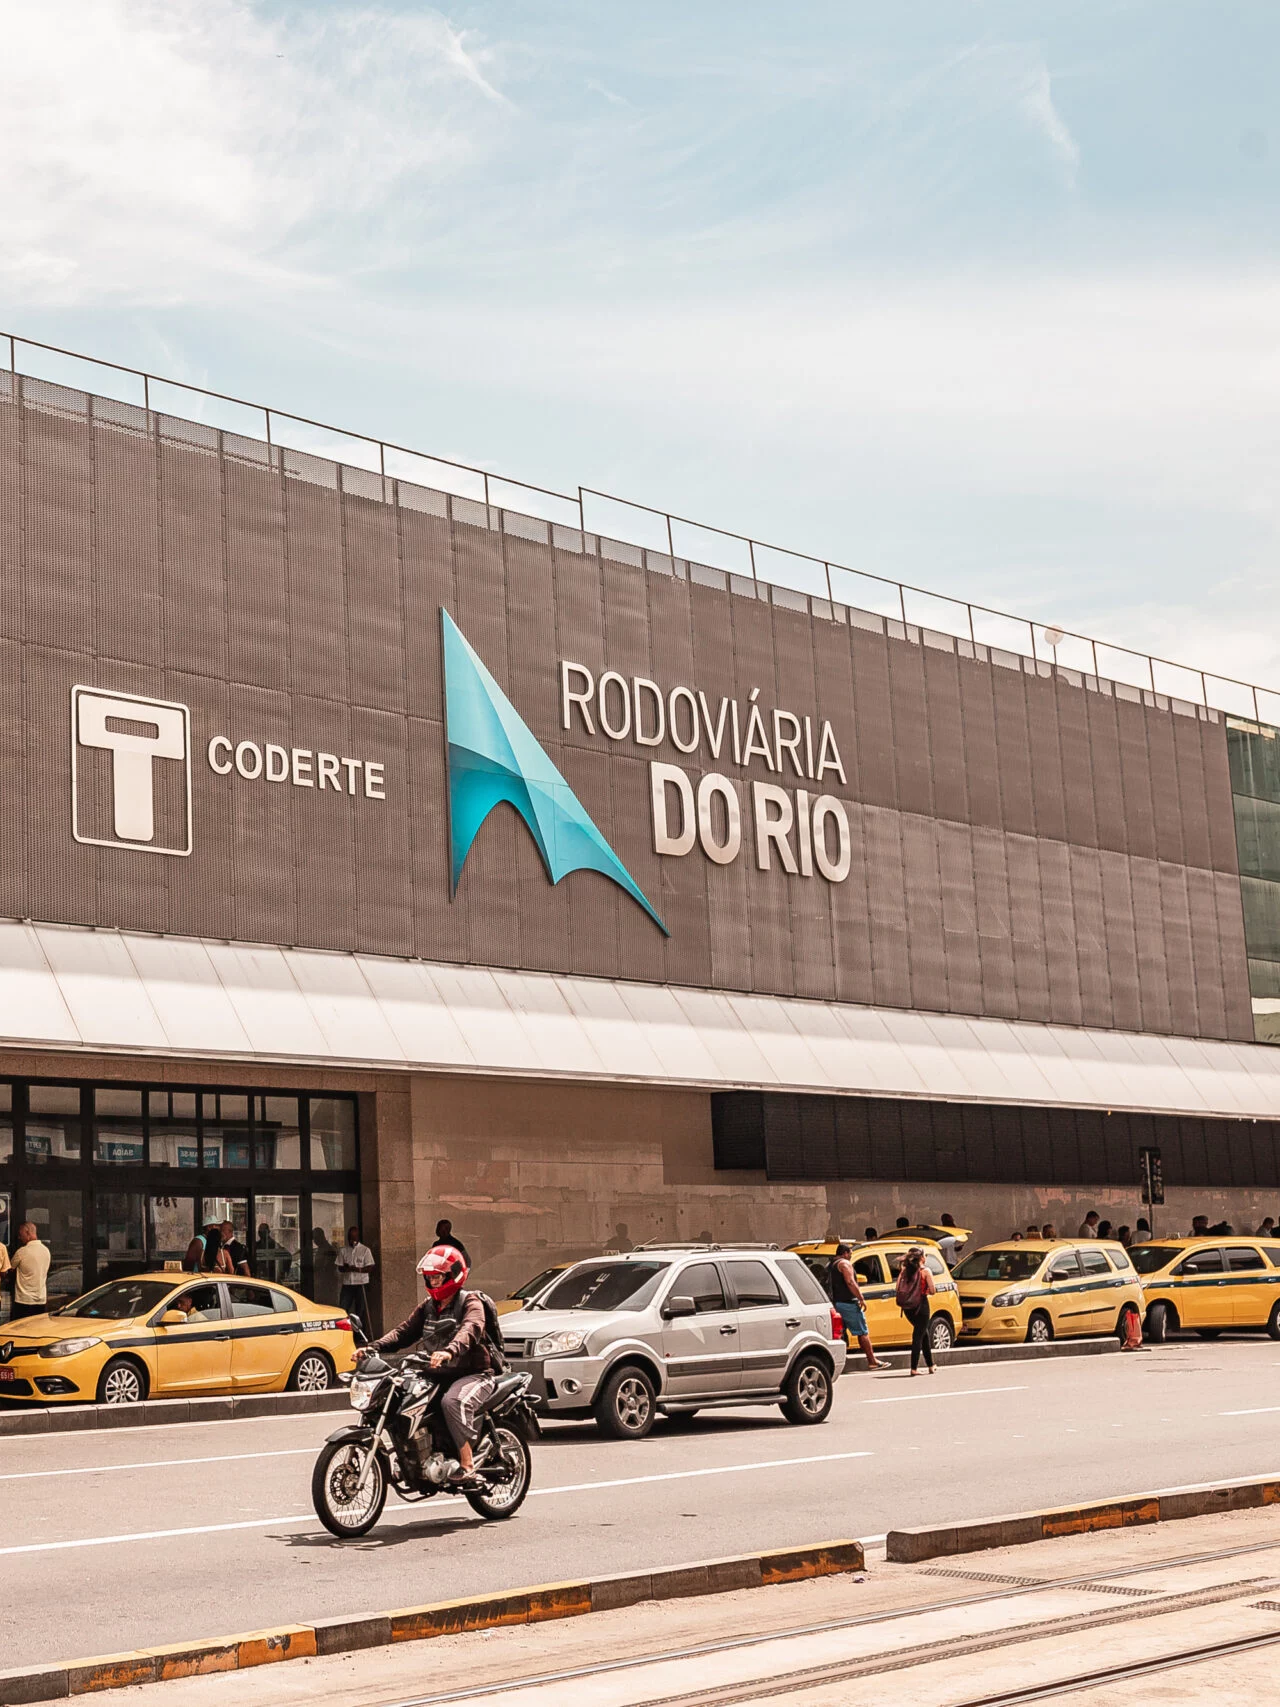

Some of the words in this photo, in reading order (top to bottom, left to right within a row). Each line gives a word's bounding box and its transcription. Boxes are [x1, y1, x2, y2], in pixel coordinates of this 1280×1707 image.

[207, 735, 386, 800] CODERTE
[560, 659, 847, 785] RODOVIÁRIA
[650, 760, 741, 865] DO
[751, 781, 852, 883] RIO
